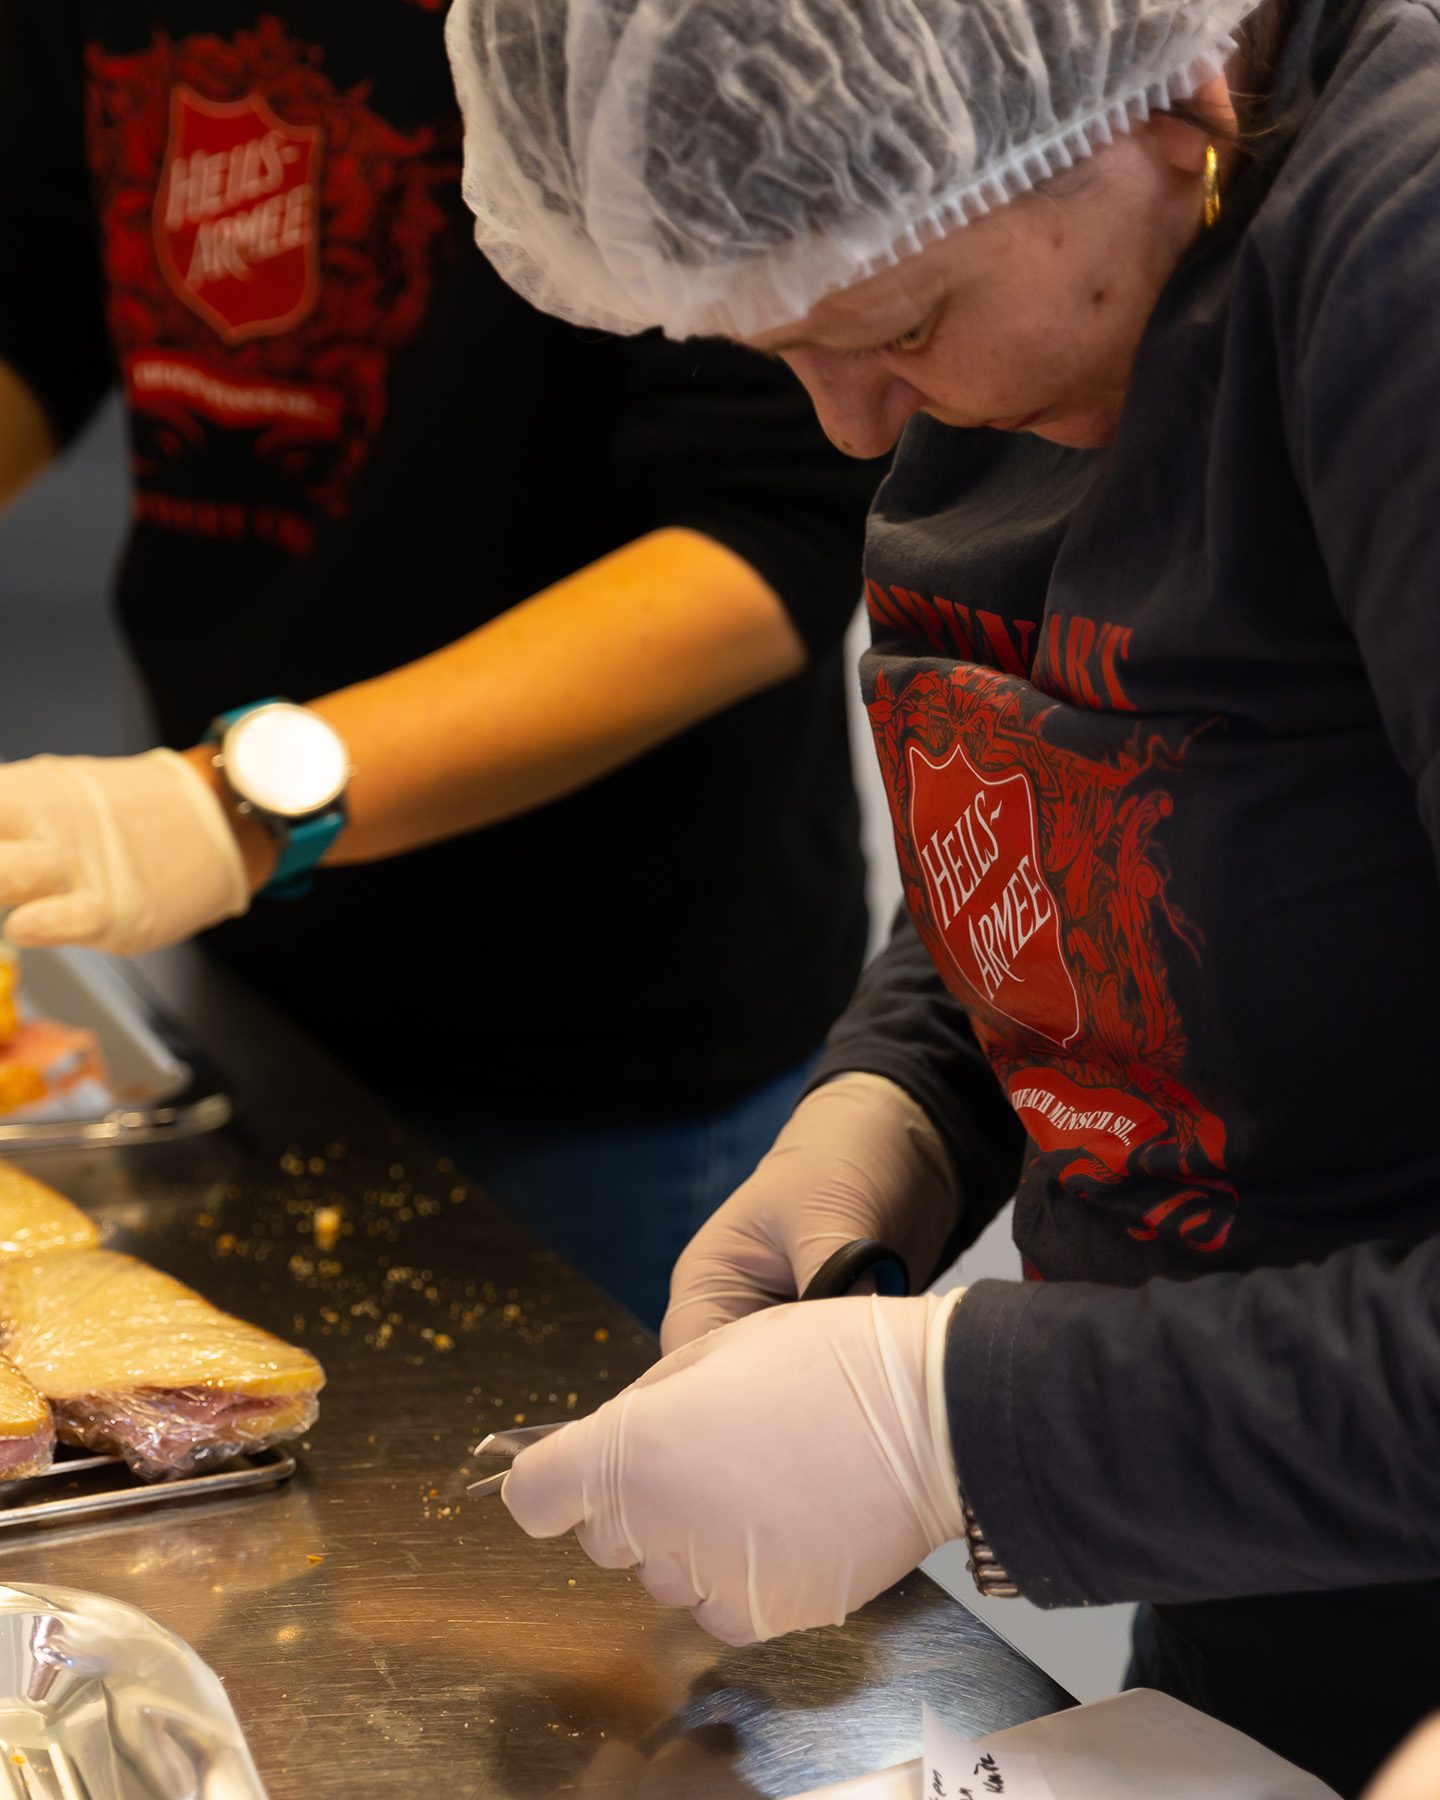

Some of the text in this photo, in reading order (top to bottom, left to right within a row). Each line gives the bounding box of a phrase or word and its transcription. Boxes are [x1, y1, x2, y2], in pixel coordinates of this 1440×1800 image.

[185, 182, 313, 290] ARMEE
[921, 789, 1003, 931] HEILS-
[968, 854, 1052, 1001] ARMEE
[1047, 1100, 1114, 1131] MÄNSCH
